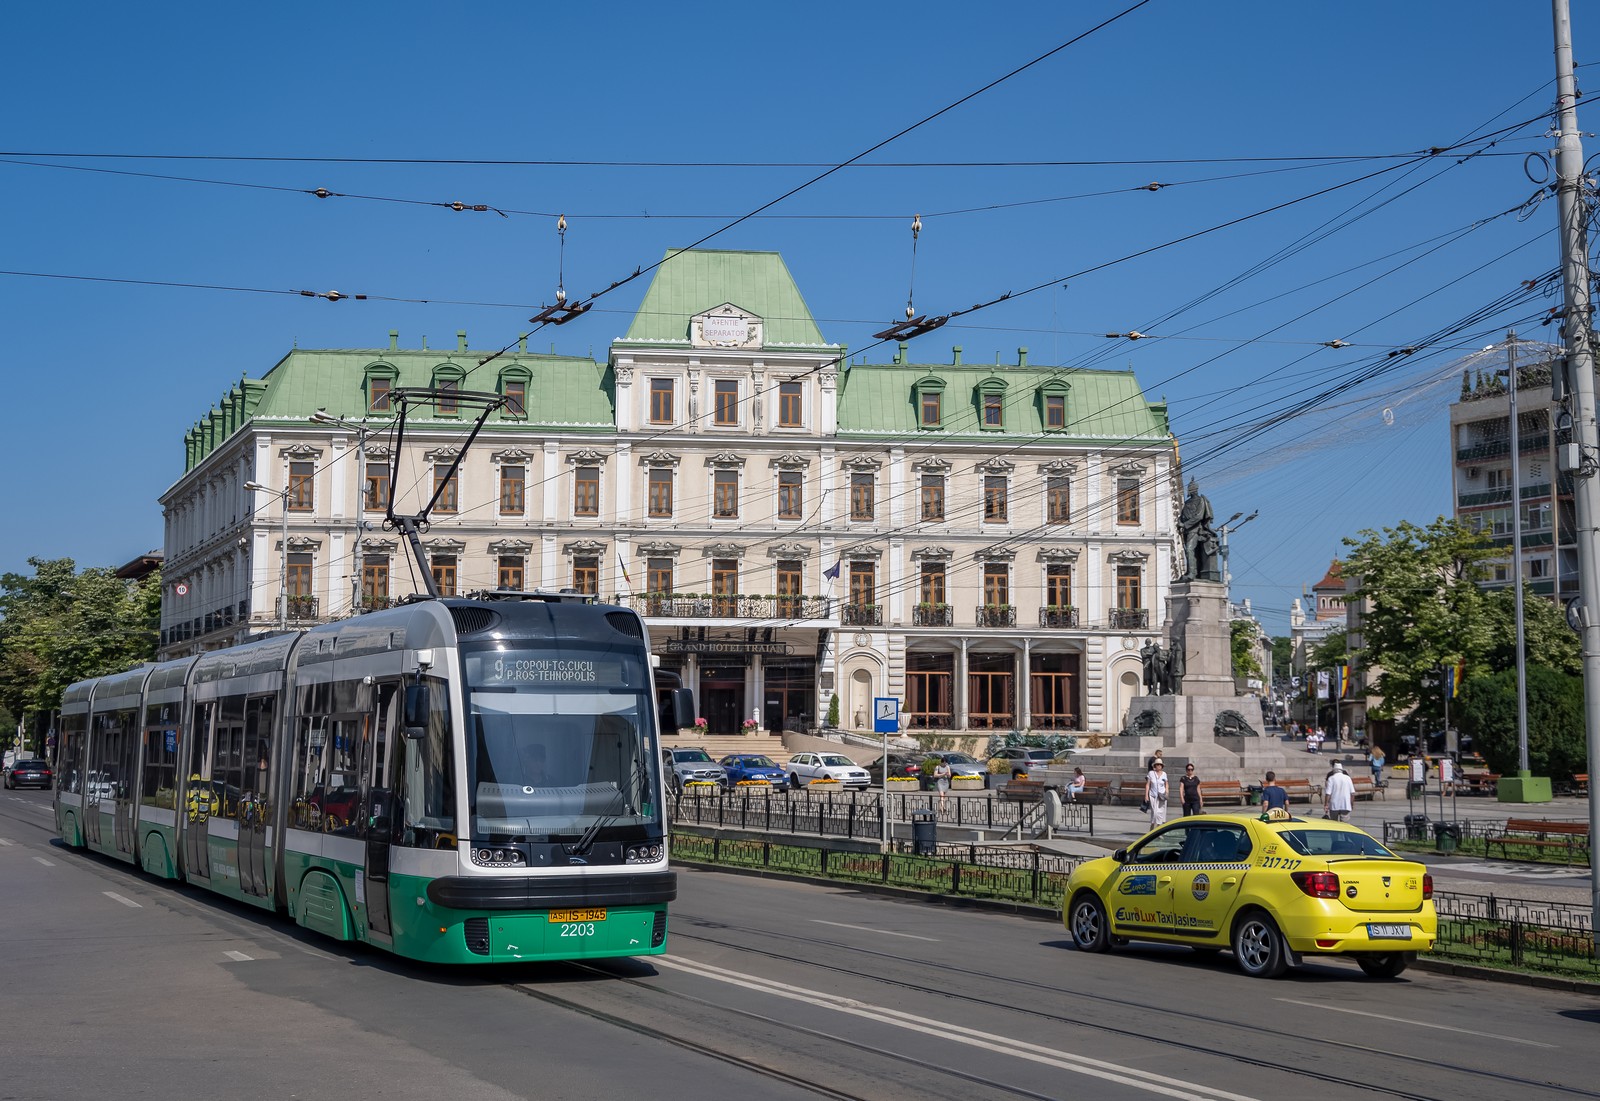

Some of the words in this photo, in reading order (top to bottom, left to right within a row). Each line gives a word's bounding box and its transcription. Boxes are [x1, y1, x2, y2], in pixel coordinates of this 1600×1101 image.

[704, 329, 745, 337] SEPARATOR
[669, 642, 706, 651] GRAND
[709, 643, 741, 652] HOTEL
[745, 644, 784, 653] TRAIAN
[515, 660, 593, 672] COPOU-TG.CUCU
[506, 670, 596, 682] P.ROS-TEHNOPOLIS
[1274, 810, 1286, 818] TAXI
[1262, 856, 1282, 868] 217
[1281, 858, 1302, 870] 217
[1156, 911, 1173, 924] Taxi
[561, 923, 595, 937] 2203
